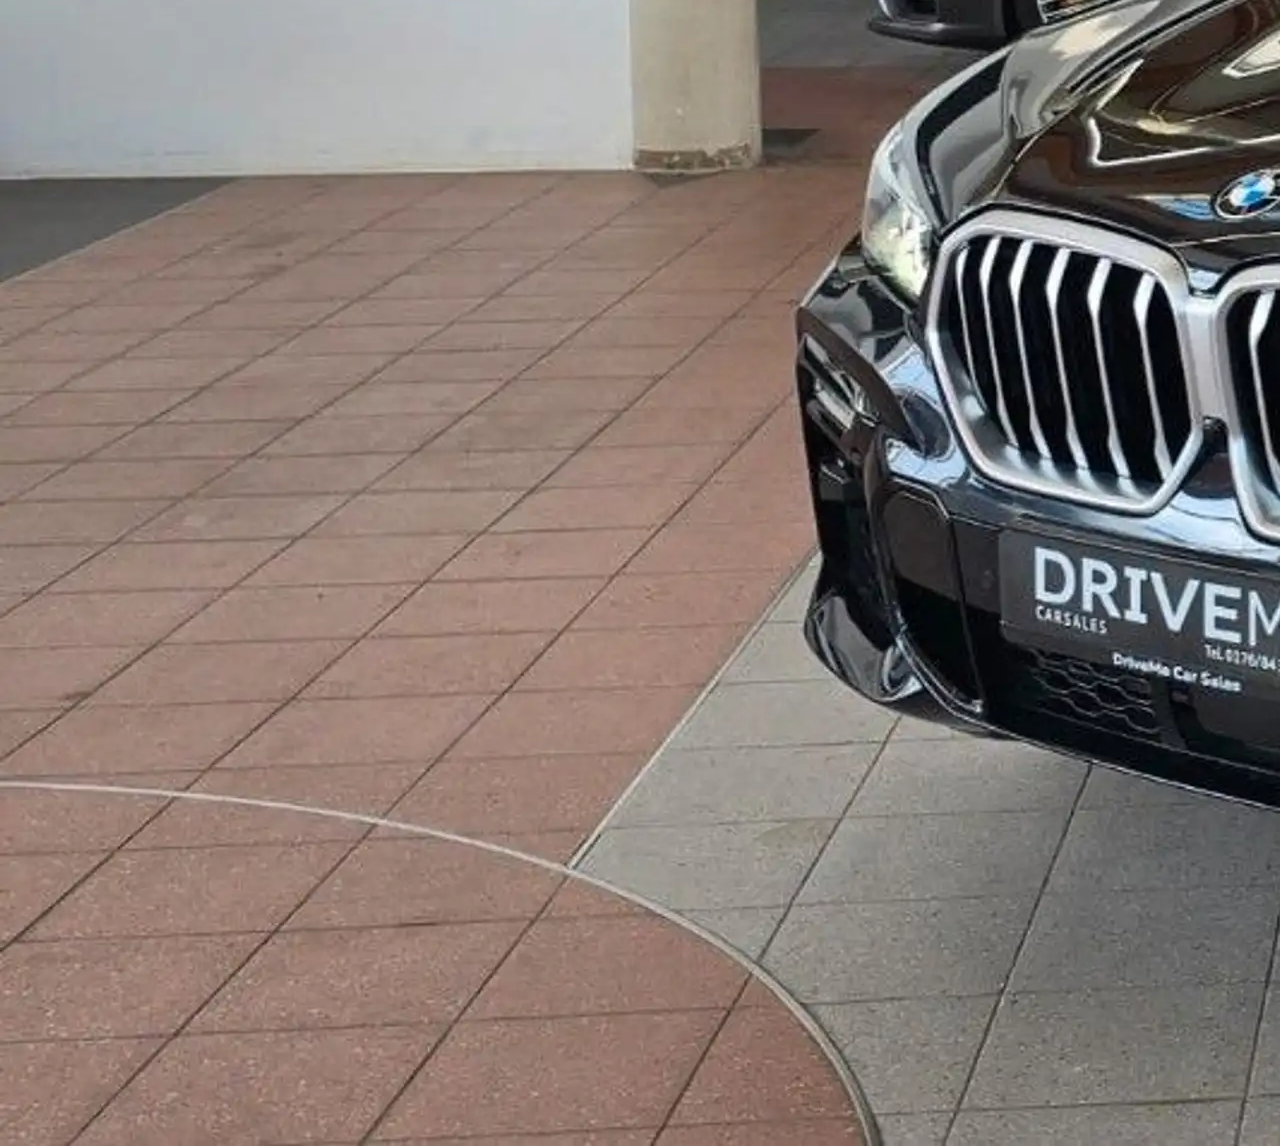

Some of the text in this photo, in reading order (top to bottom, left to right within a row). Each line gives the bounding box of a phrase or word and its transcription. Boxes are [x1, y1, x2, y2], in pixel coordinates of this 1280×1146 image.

[1035, 604, 1108, 635] CARSALES
[1173, 665, 1198, 684] Car
[1200, 670, 1242, 692] Sales
